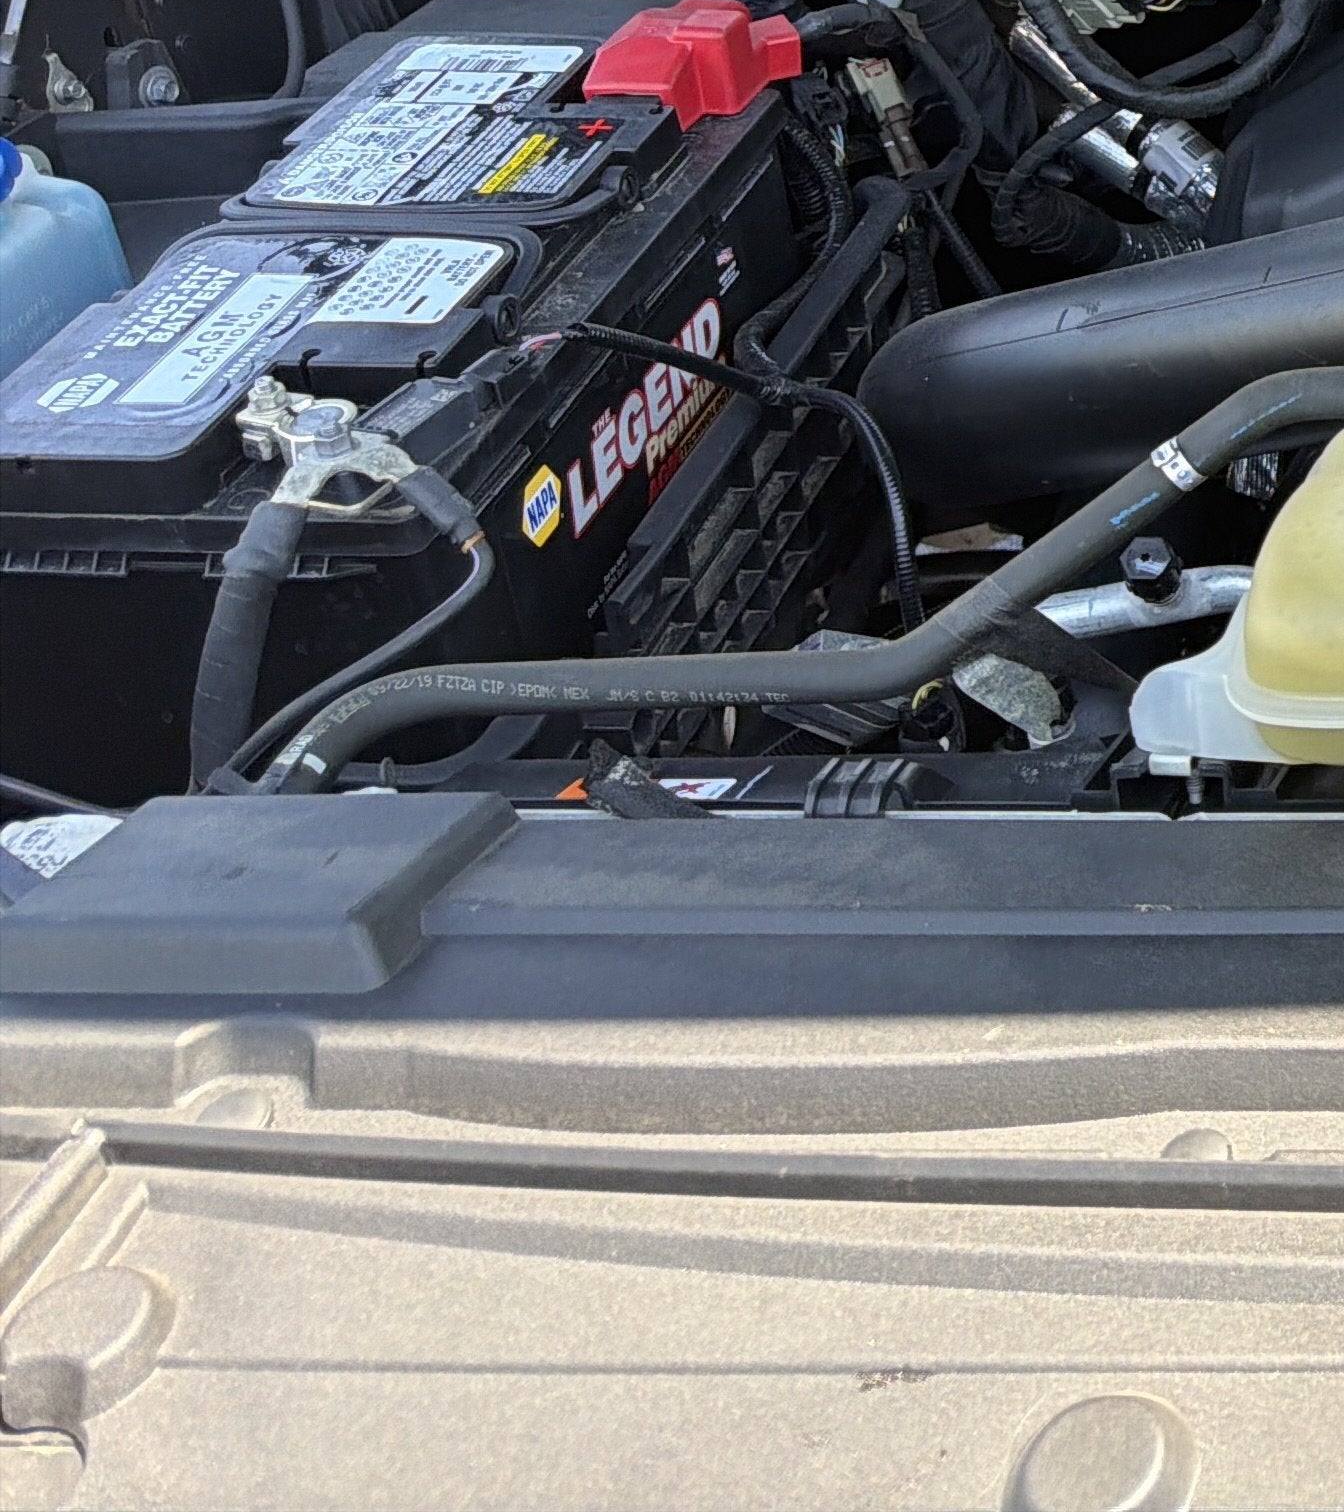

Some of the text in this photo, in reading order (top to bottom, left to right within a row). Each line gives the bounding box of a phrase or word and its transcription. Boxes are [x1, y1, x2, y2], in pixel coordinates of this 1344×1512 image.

[145, 268, 240, 343] BATTERY
[181, 293, 282, 382] TECHNOLOGY
[567, 299, 721, 539] LEGEND
[591, 405, 613, 438] THE
[526, 475, 558, 535] NAPA
